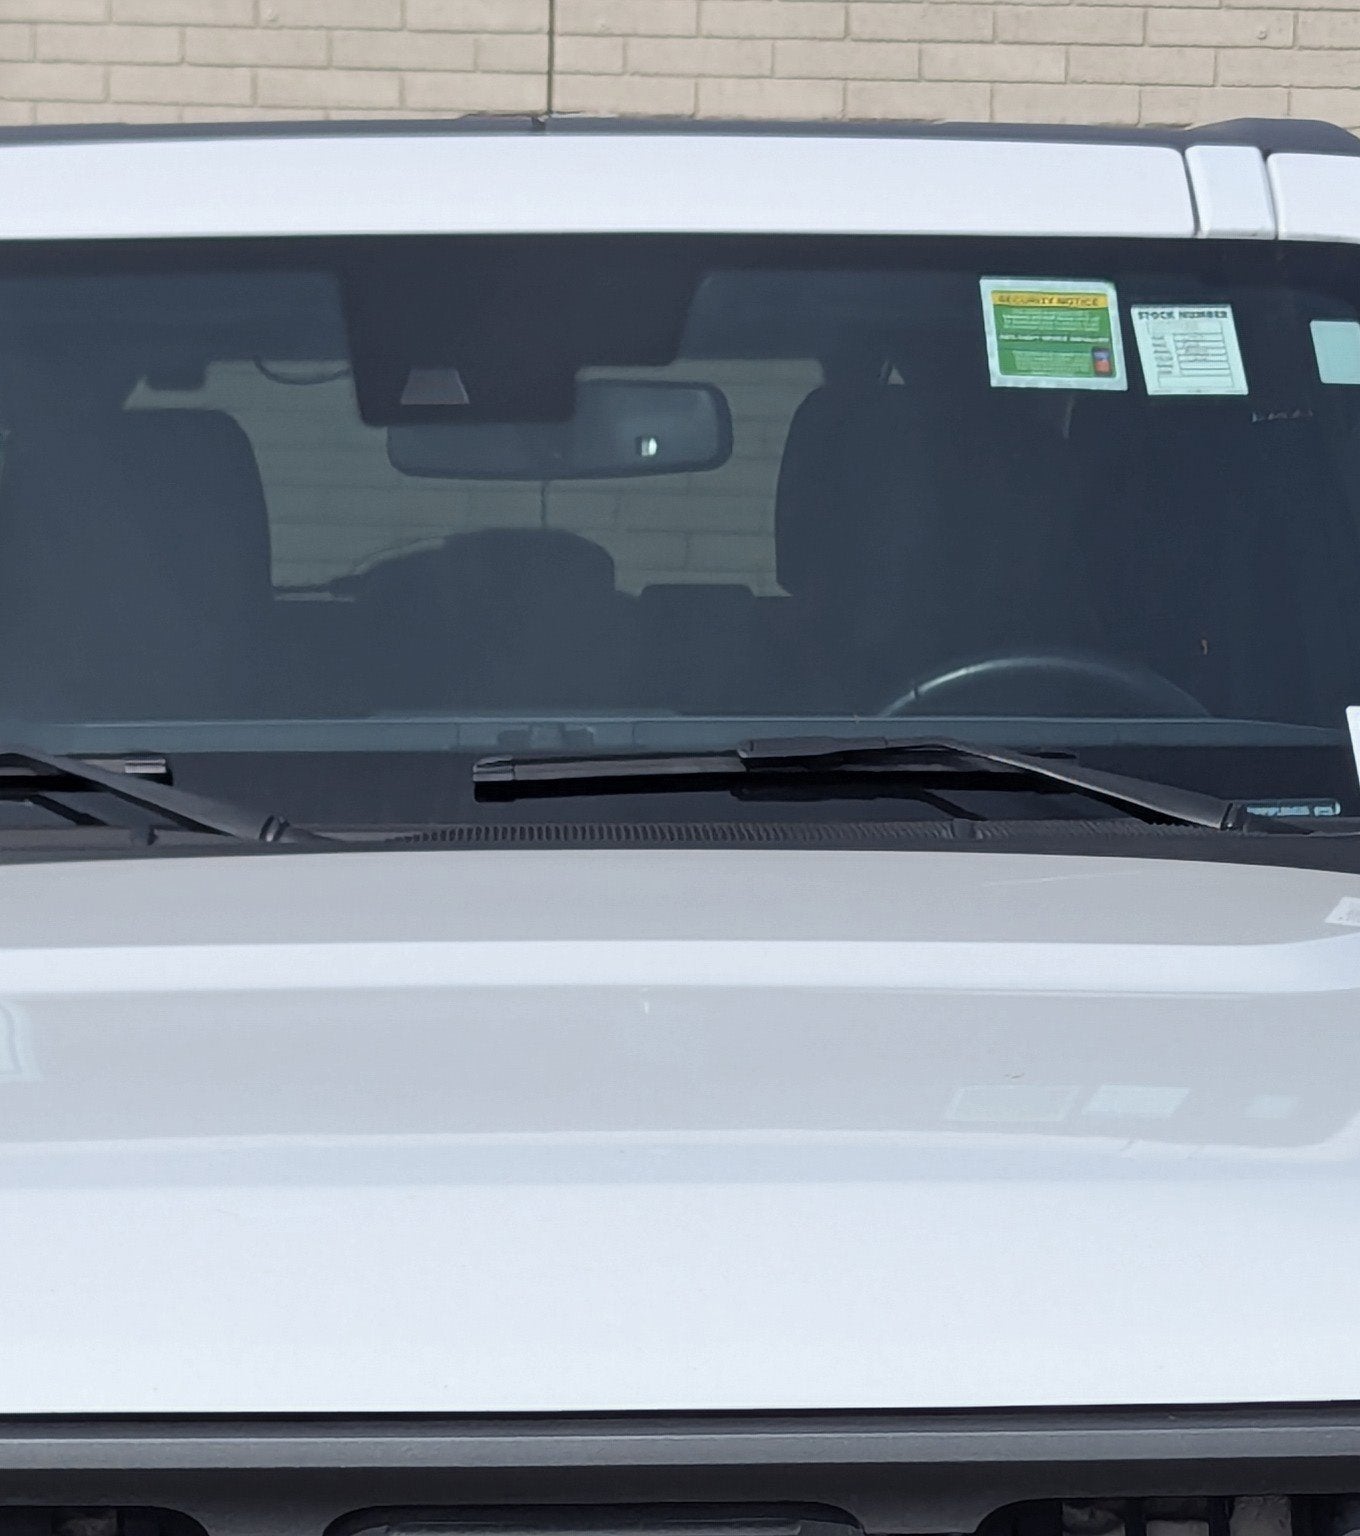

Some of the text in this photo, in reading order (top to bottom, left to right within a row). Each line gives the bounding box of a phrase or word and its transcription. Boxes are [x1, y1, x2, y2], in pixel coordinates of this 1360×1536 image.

[1057, 296, 1100, 307] NOTICE
[1138, 310, 1228, 320] STOCK NUMBER
